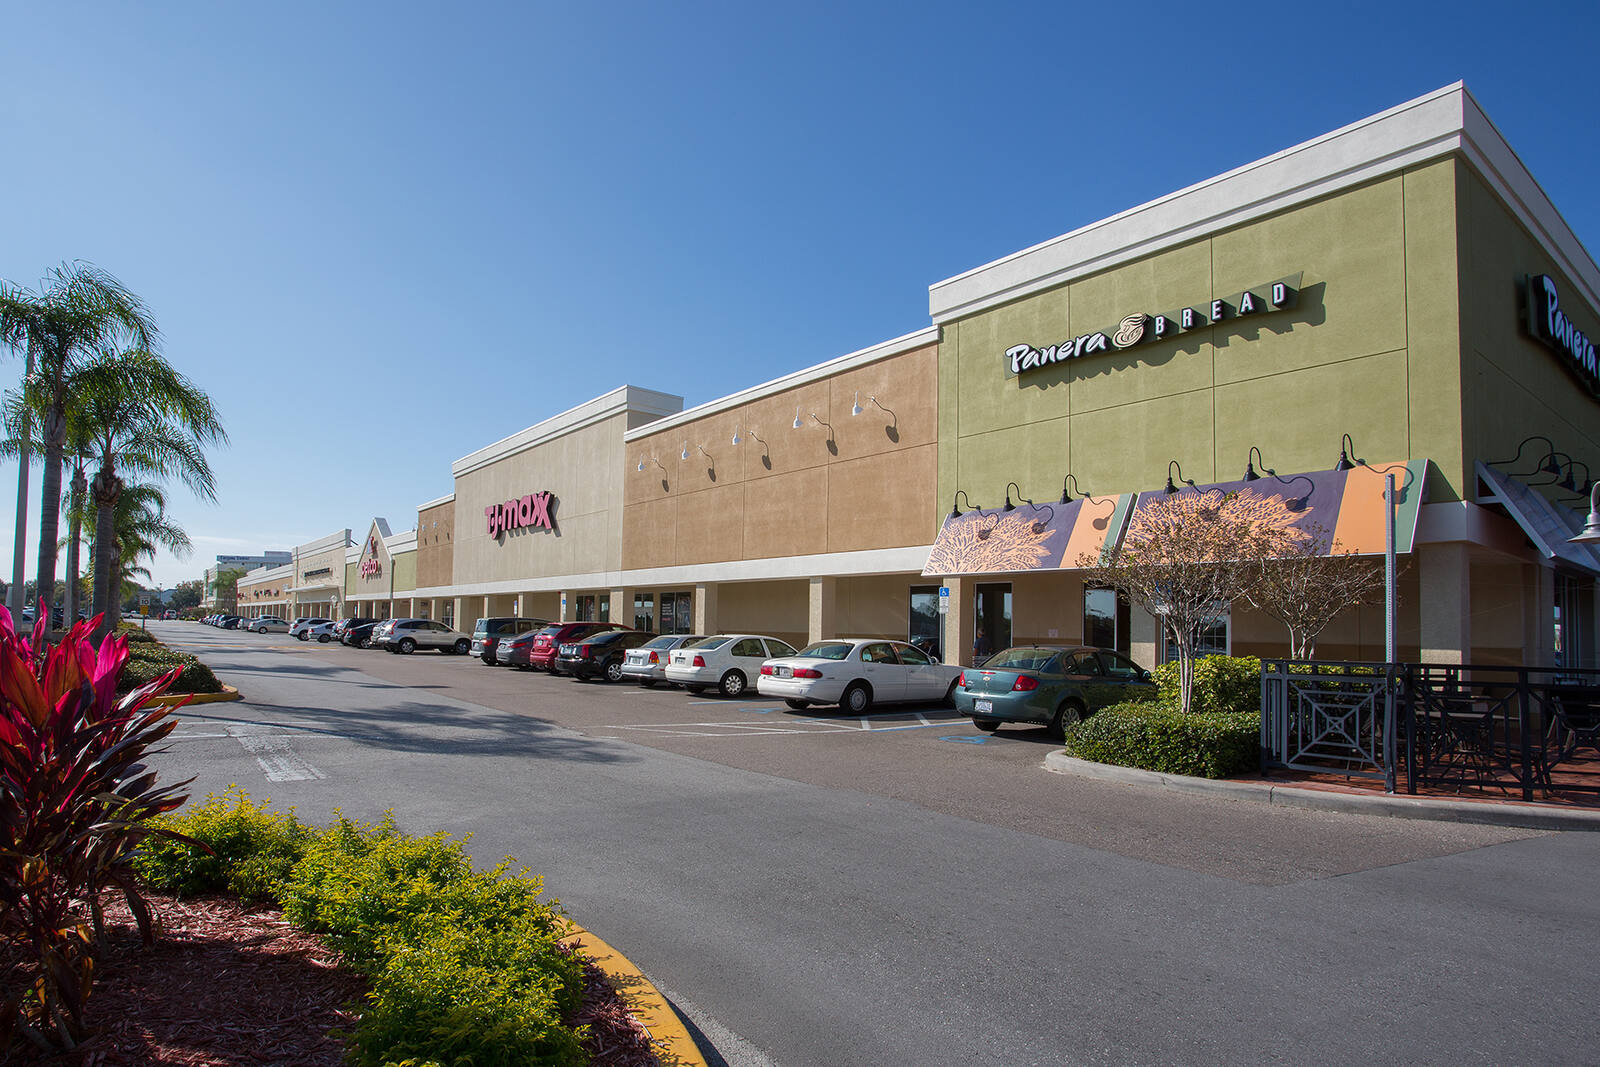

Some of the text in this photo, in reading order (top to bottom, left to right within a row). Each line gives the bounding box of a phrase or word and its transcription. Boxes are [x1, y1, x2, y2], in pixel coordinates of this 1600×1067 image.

[1005, 282, 1285, 374] Panera BREAD
[1543, 274, 1597, 377] Panera
